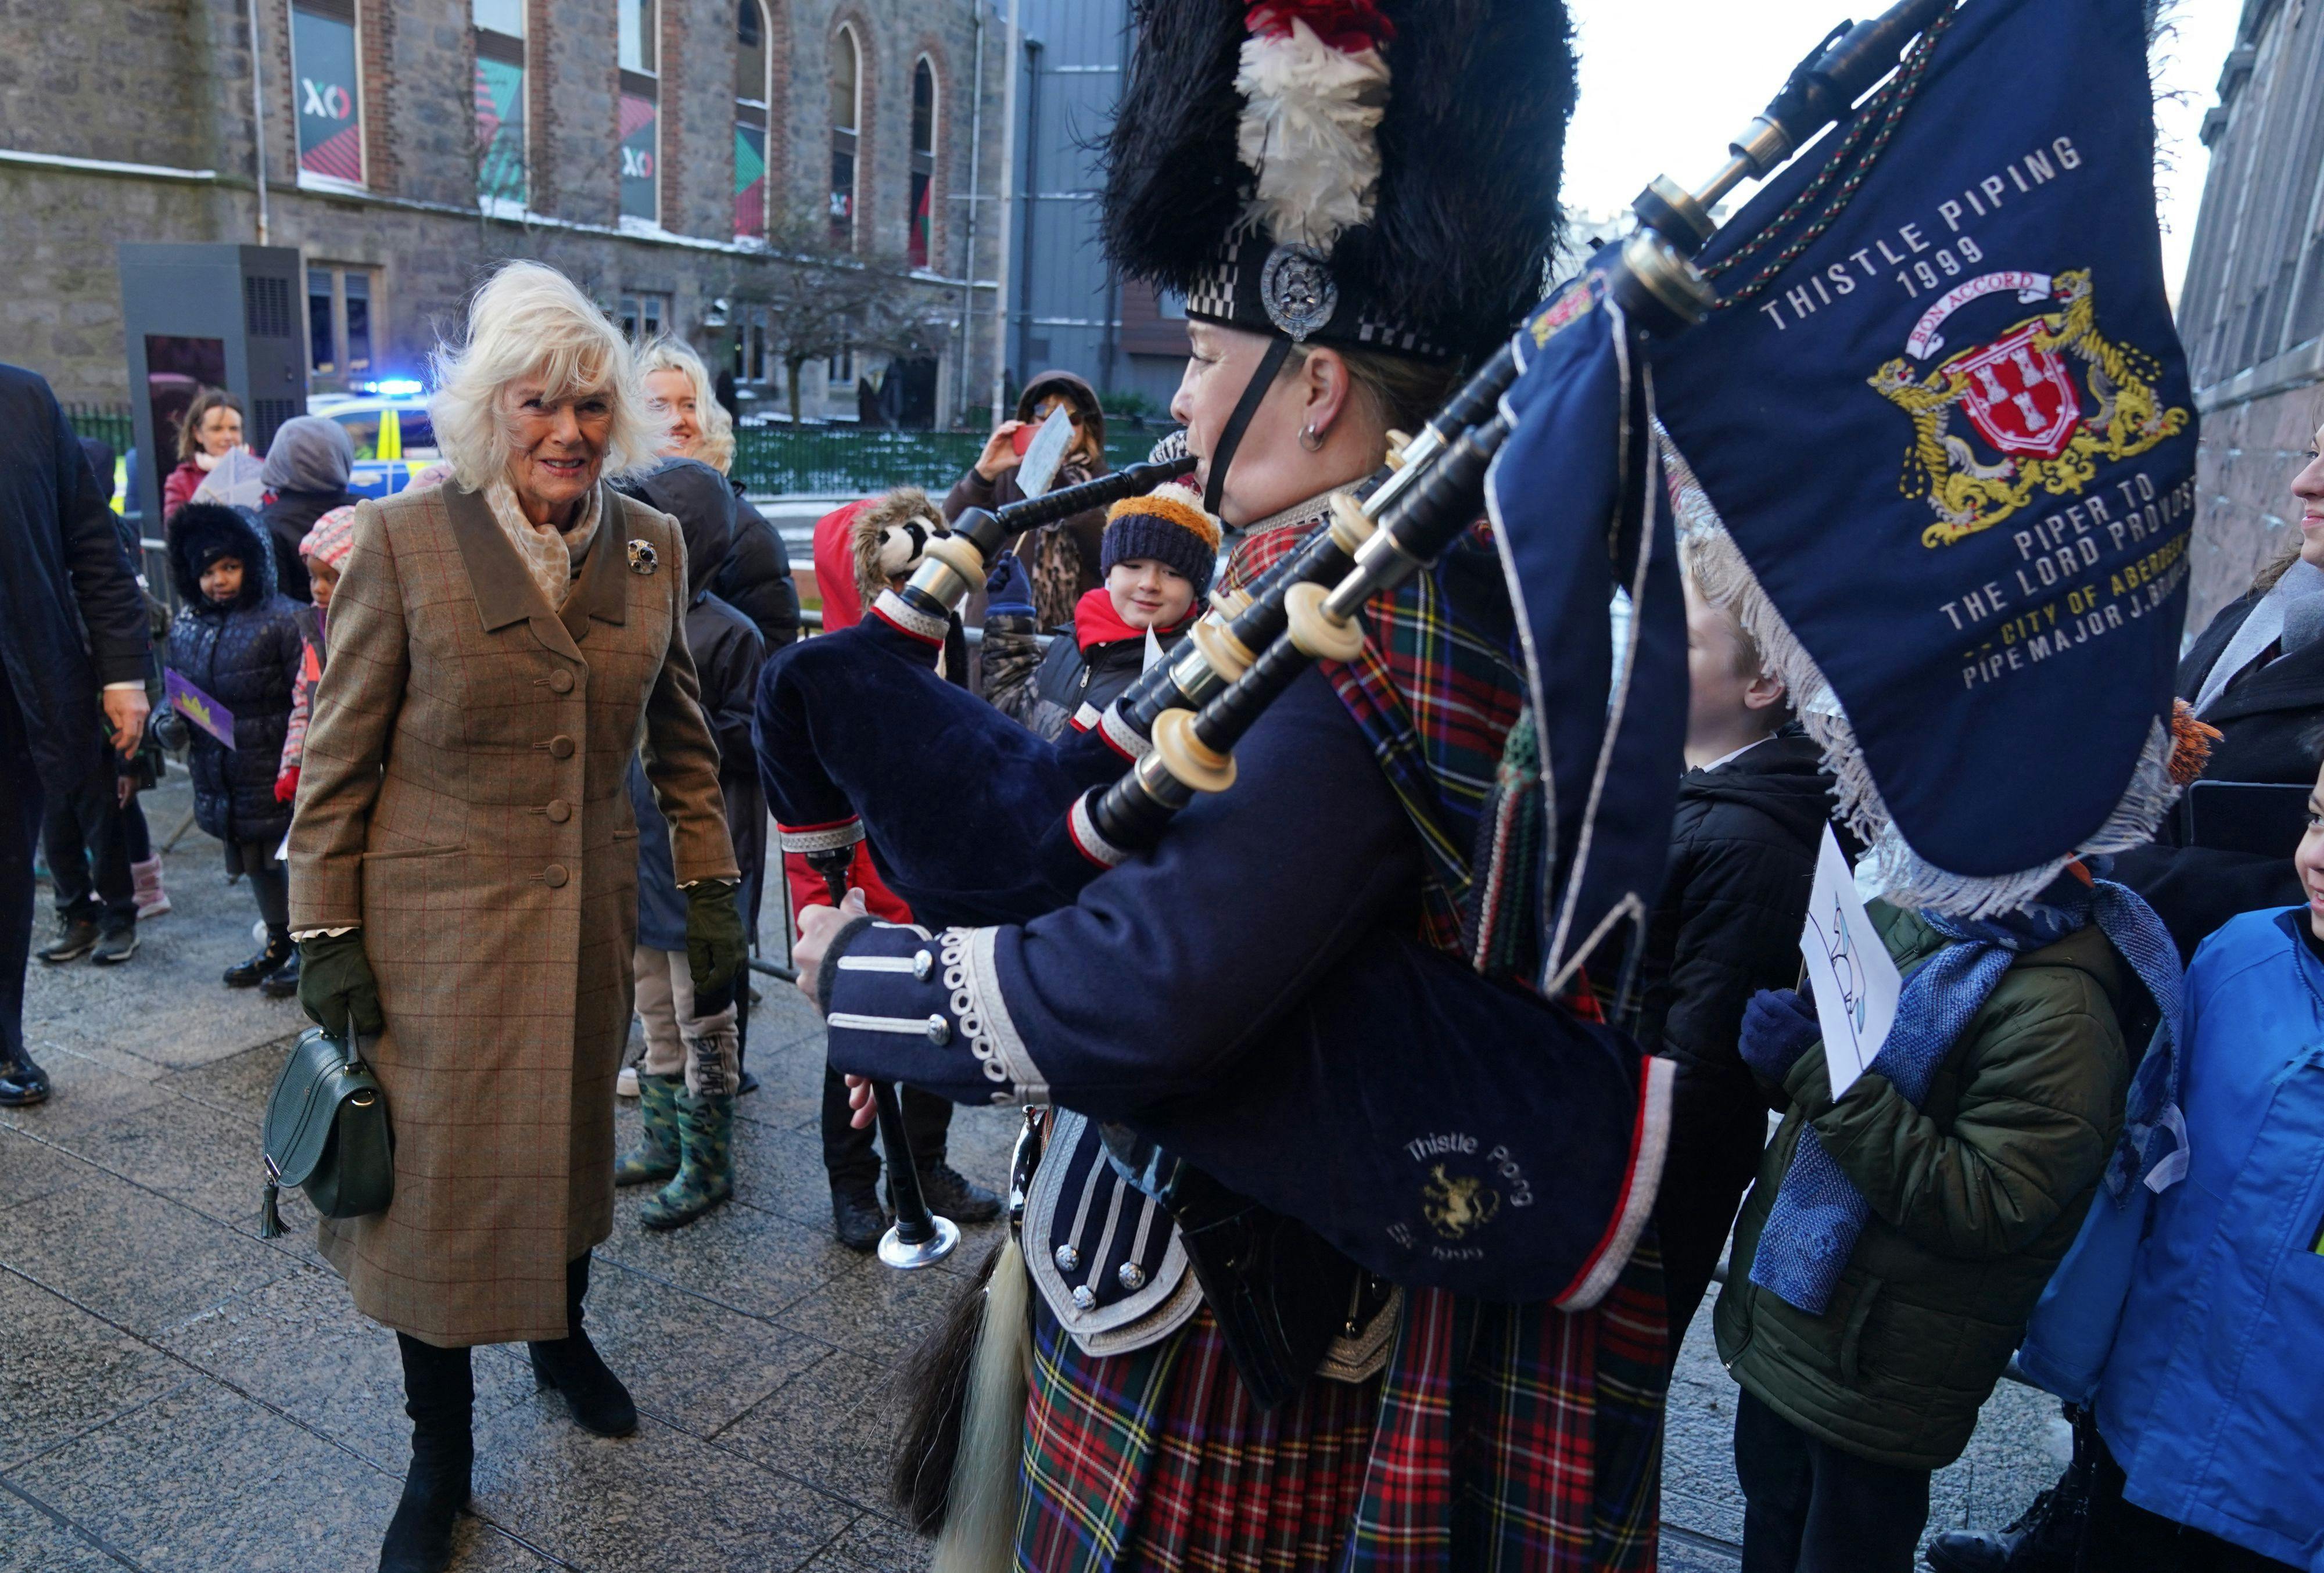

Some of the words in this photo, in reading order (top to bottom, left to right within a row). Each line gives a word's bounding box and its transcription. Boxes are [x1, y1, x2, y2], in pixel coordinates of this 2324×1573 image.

[302, 77, 352, 120] XO
[622, 145, 654, 179] XO
[1759, 222, 1931, 331] THISTLE
[1937, 135, 2083, 233] PIPING
[1896, 236, 1984, 299] 1999
[1910, 304, 1946, 343] BON
[1949, 271, 2034, 308] ACCORD
[2013, 494, 2111, 562] PIPER
[2117, 472, 2155, 509] TO
[1938, 580, 2009, 630] THE
[2014, 536, 2100, 596] LORD
[2107, 475, 2196, 551] PROVOS
[1962, 646, 2025, 689] PIPE
[2027, 603, 2124, 663] MAJOR
[2001, 602, 2059, 645] CITY
[2067, 584, 2098, 615] OF
[1403, 1131, 1479, 1162] Thistle
